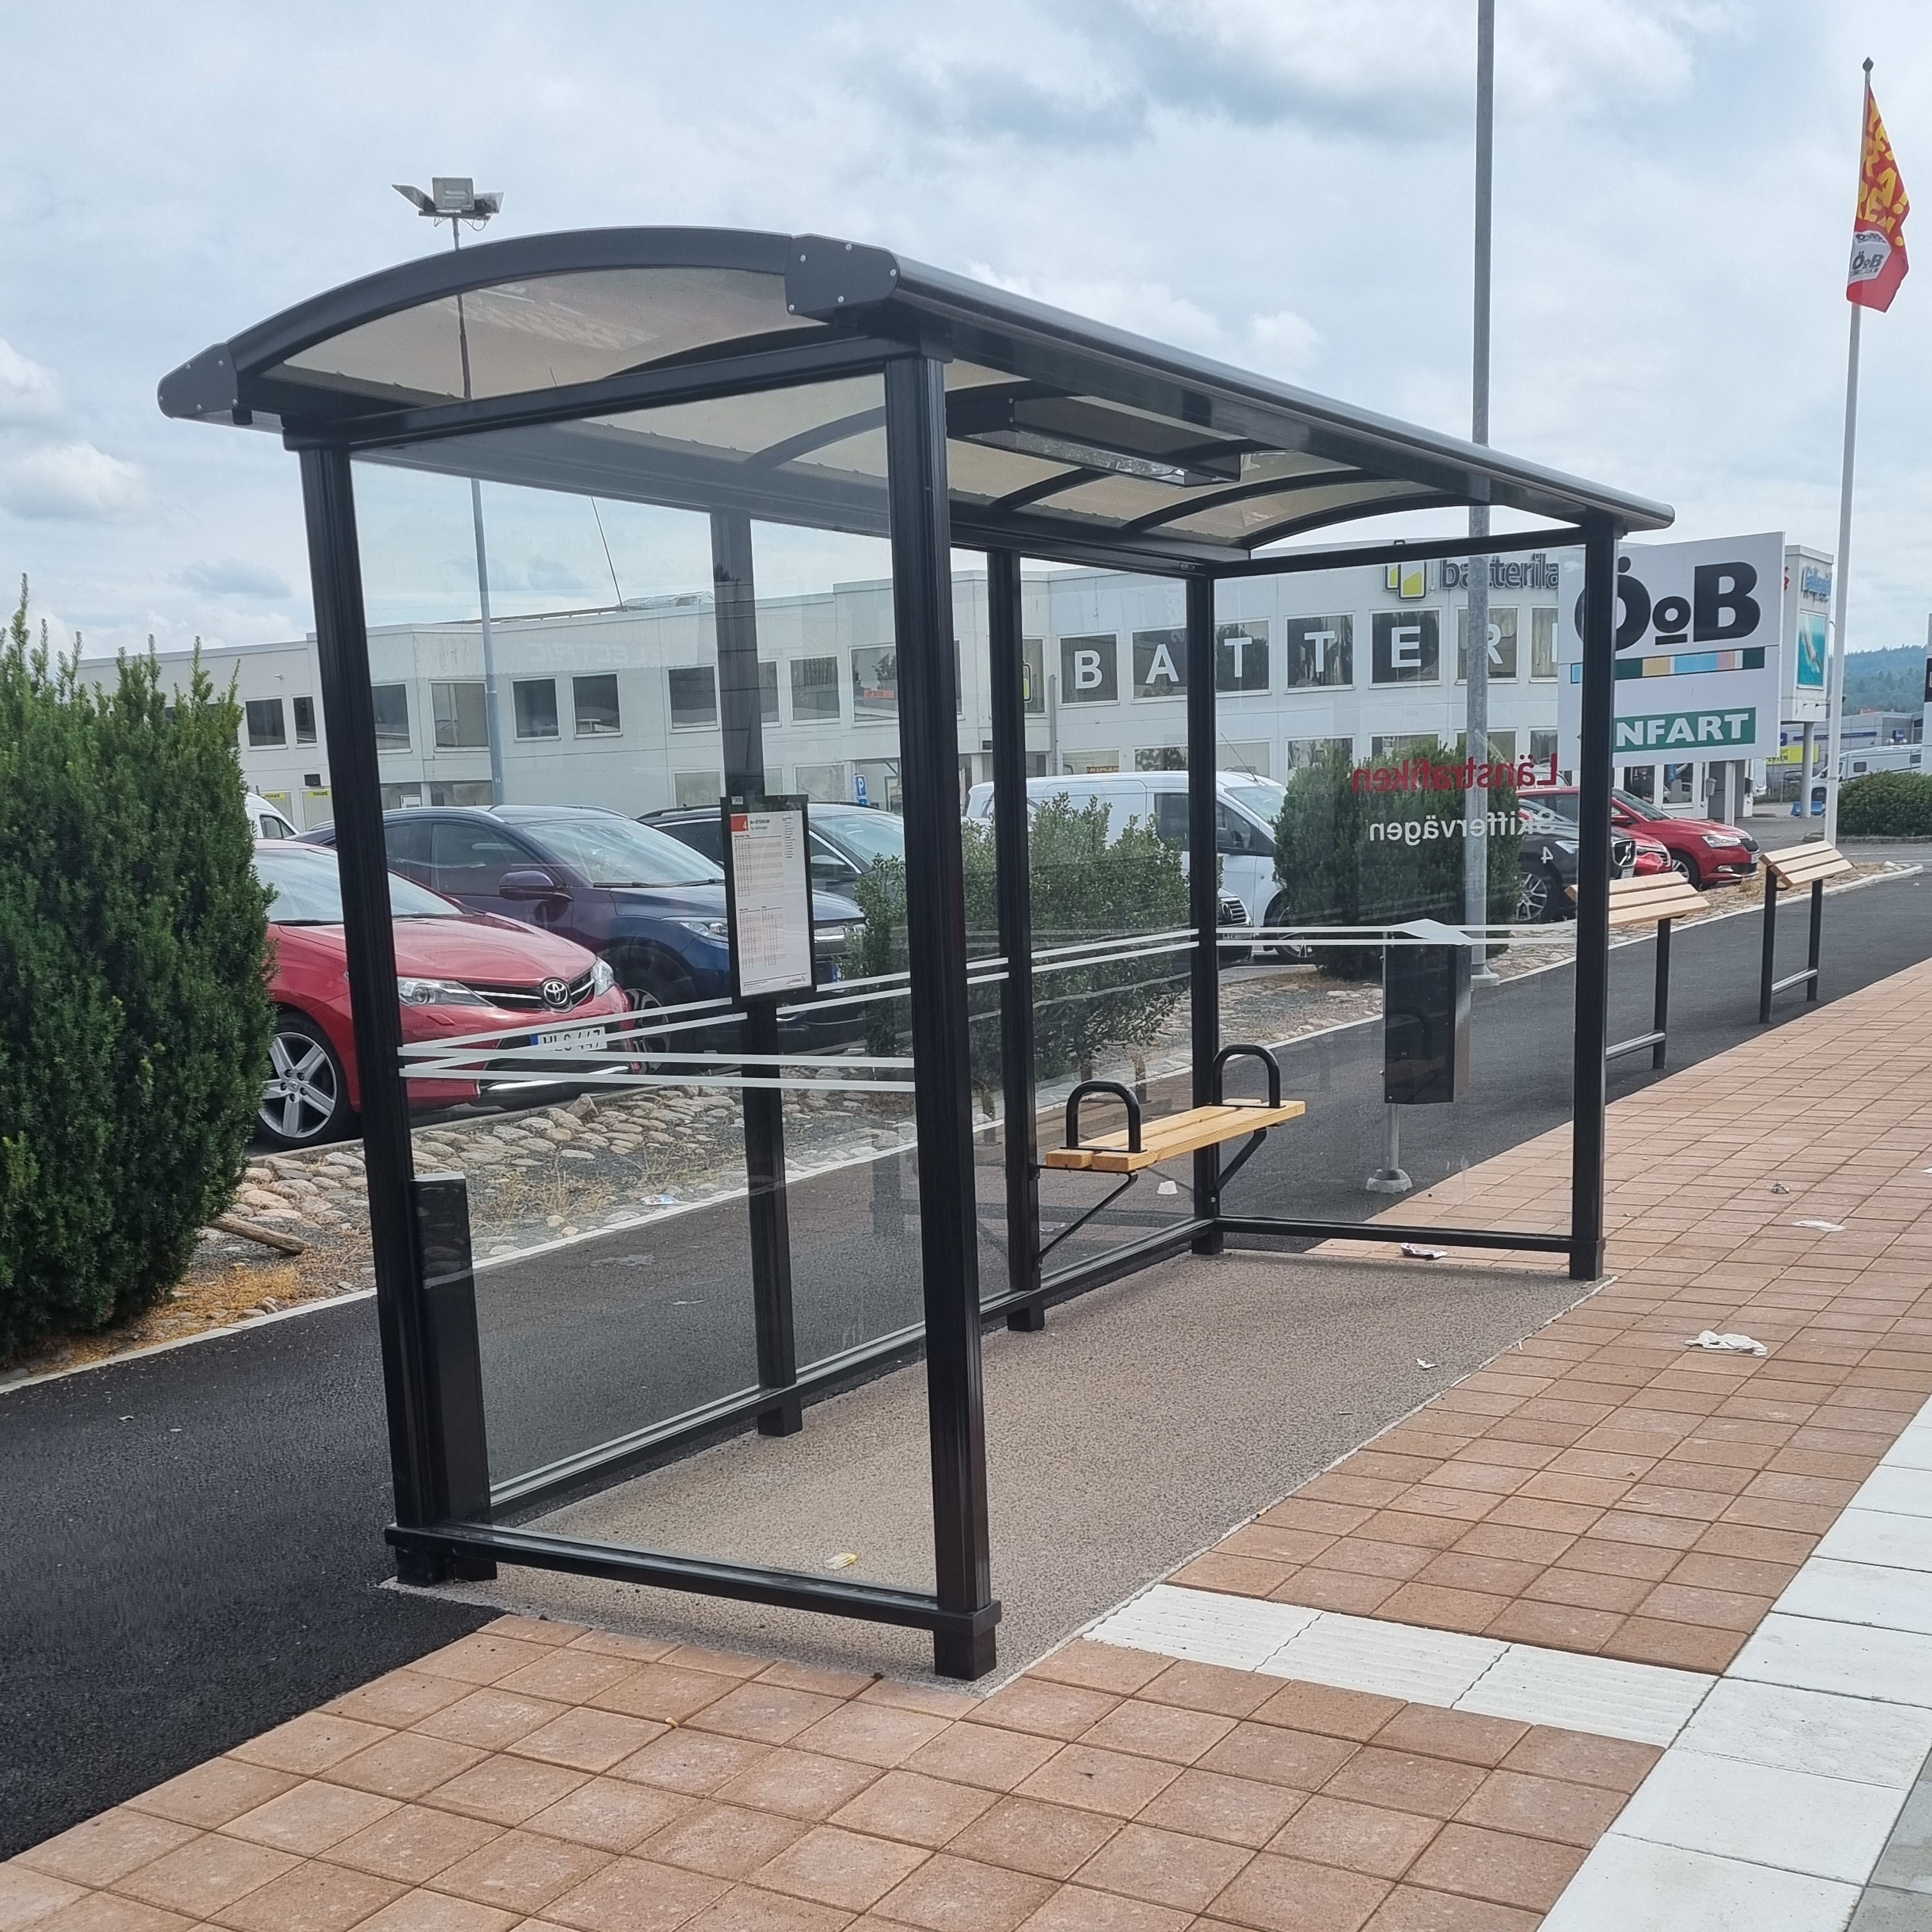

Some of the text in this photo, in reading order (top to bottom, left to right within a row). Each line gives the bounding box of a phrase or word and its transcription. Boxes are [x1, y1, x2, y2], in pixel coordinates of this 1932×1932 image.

[1852, 250, 1884, 270] ÖoB
[1441, 553, 1559, 588] bterila
[1616, 714, 1749, 746] NFART
